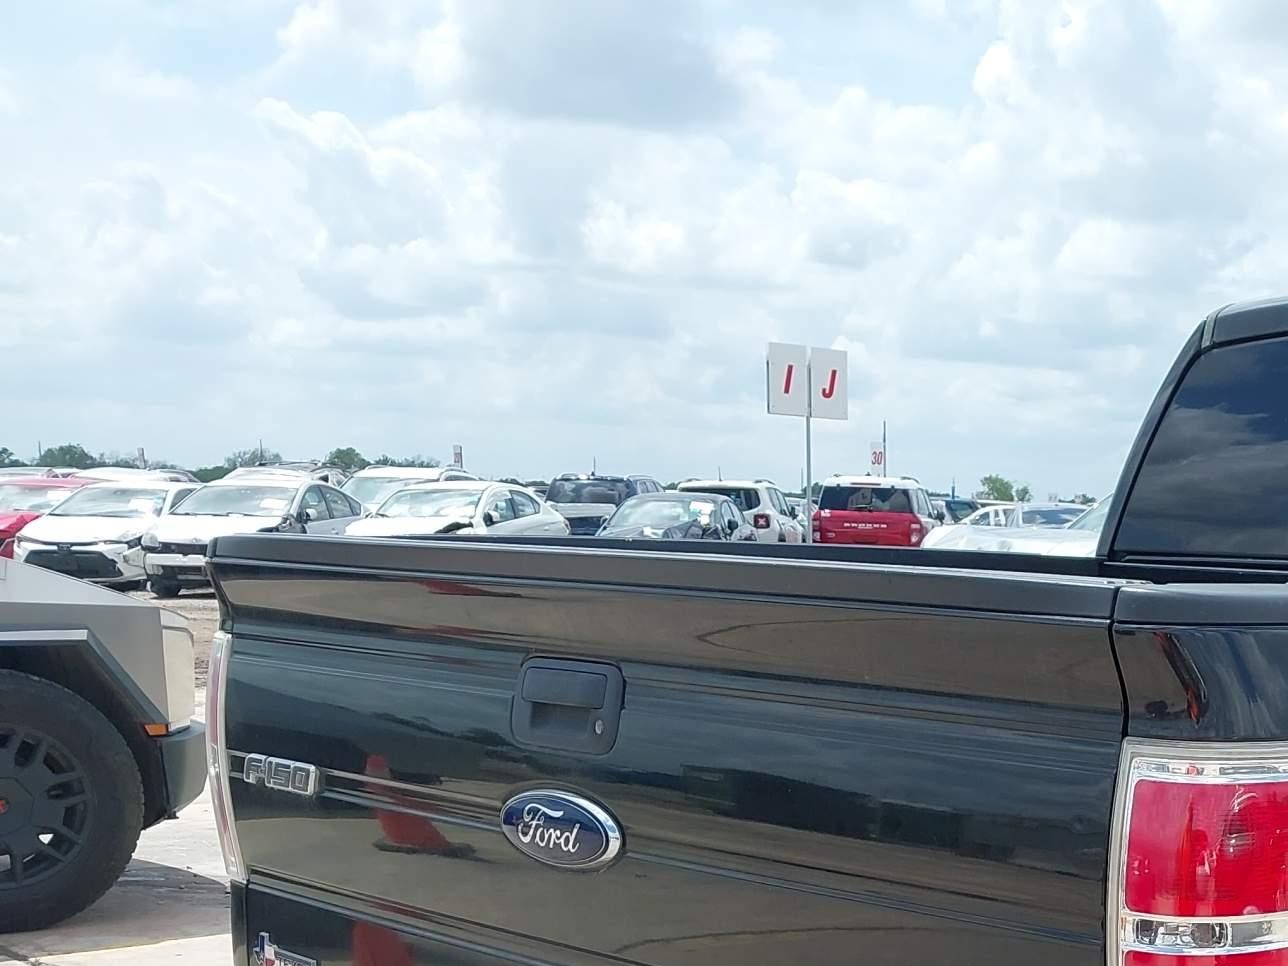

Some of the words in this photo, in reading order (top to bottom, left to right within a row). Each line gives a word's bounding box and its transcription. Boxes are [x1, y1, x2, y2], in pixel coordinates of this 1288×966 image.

[783, 363, 794, 395] I
[821, 368, 838, 399] J
[871, 450, 883, 466] 30
[517, 802, 581, 854] Ford
